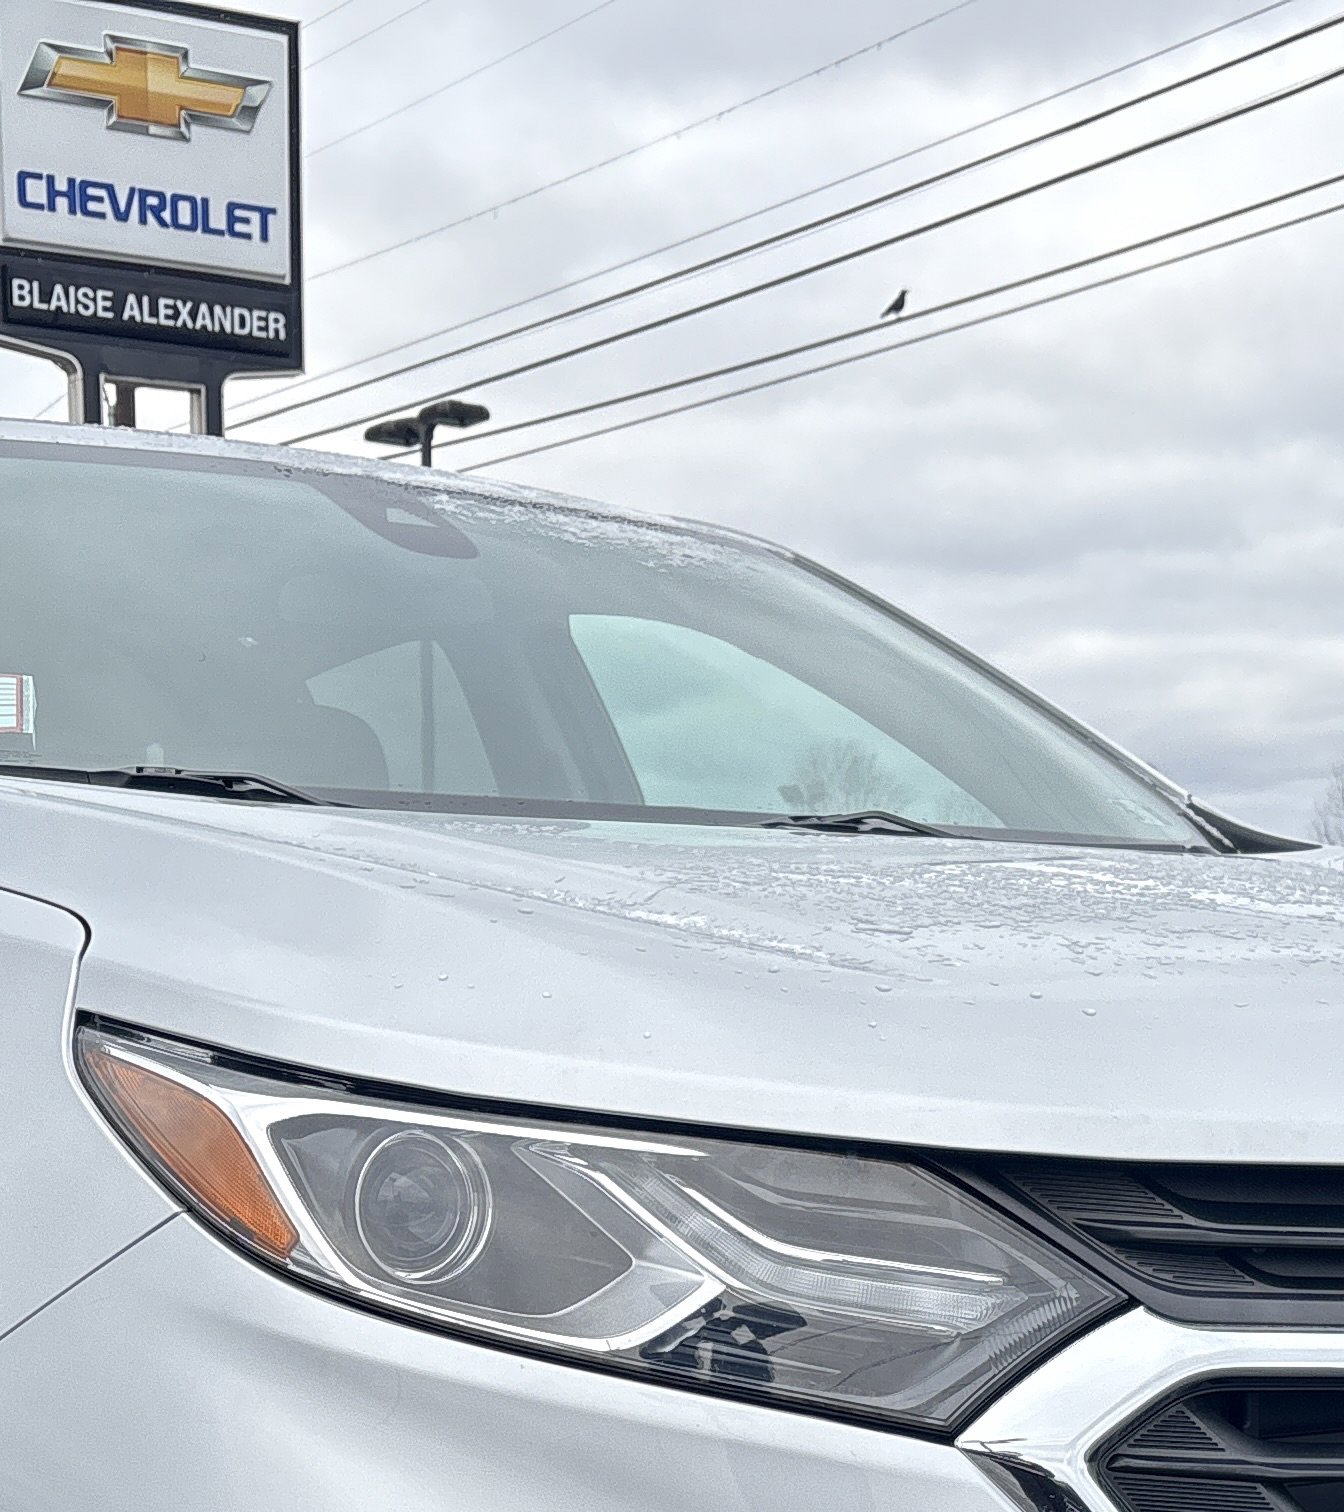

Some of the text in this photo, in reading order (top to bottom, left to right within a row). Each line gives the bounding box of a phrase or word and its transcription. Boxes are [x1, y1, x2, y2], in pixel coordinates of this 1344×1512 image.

[17, 170, 277, 243] CHEVROLET
[11, 277, 287, 341] BLAISE ALEXANDER
